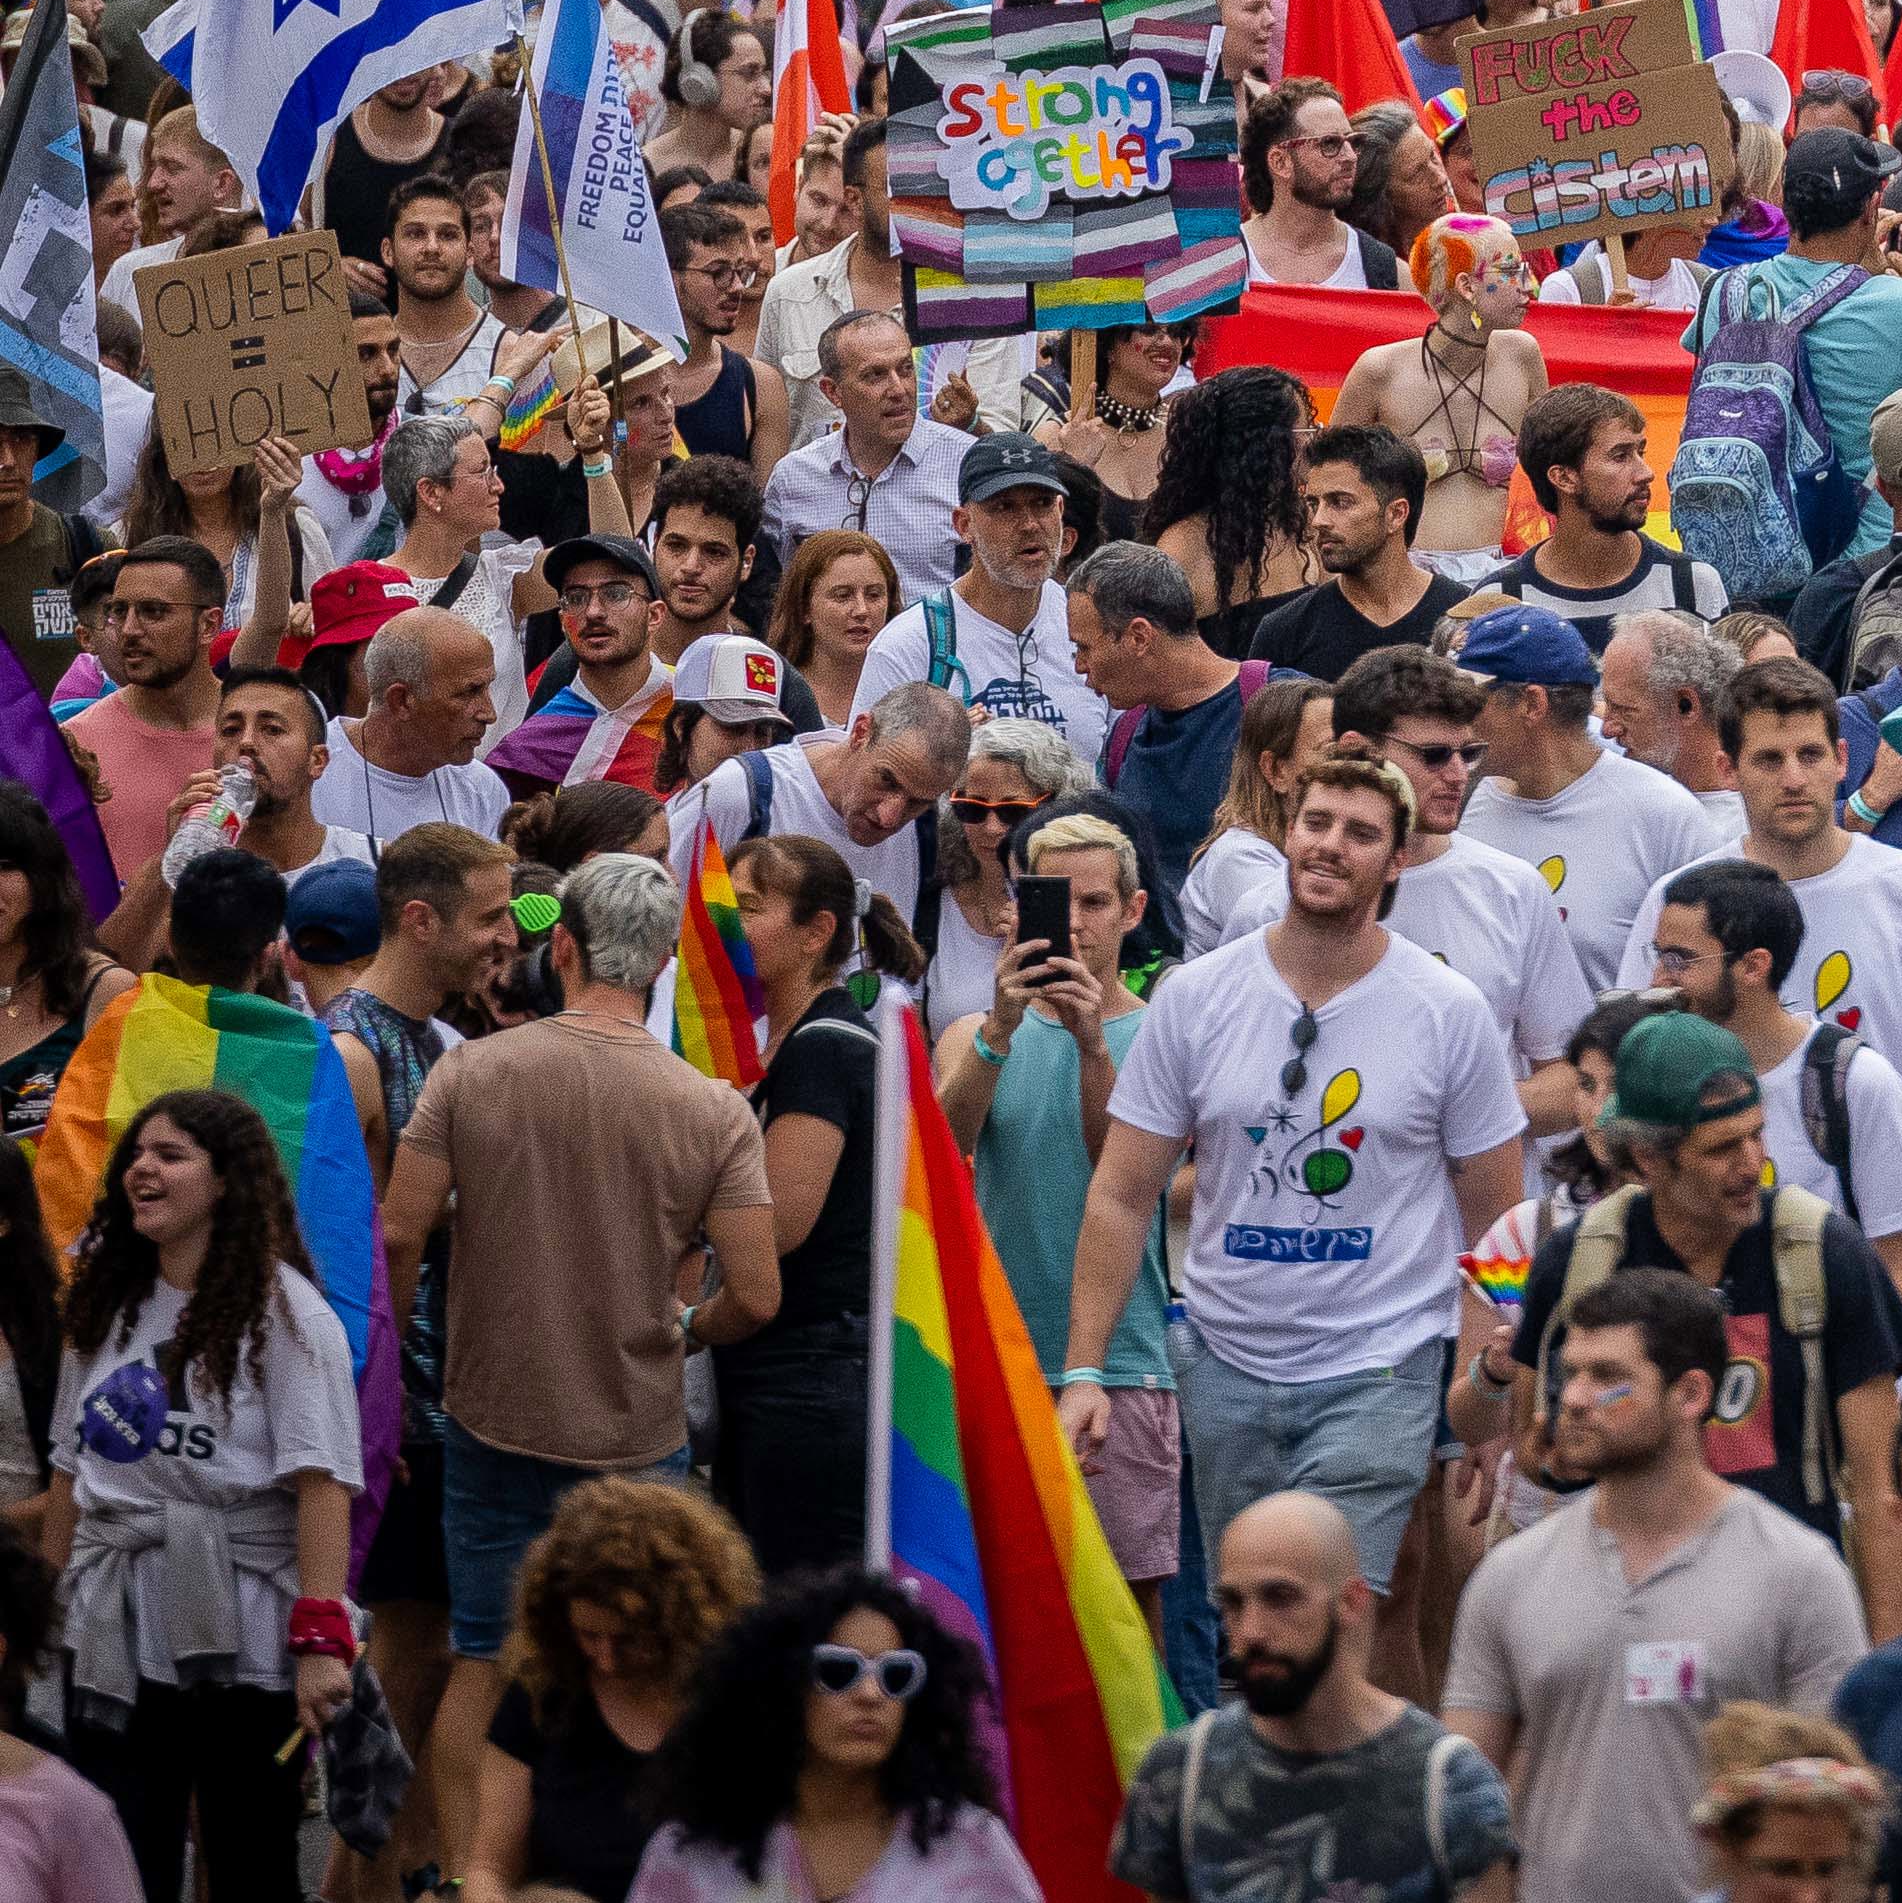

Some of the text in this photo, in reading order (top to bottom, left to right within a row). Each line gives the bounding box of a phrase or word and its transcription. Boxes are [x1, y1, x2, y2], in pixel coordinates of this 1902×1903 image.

[1471, 16, 1640, 106] FUCK
[1541, 89, 1642, 144] the
[577, 113, 614, 230] FREEDOM
[155, 249, 338, 338] QUEER
[184, 369, 341, 460] HOLY
